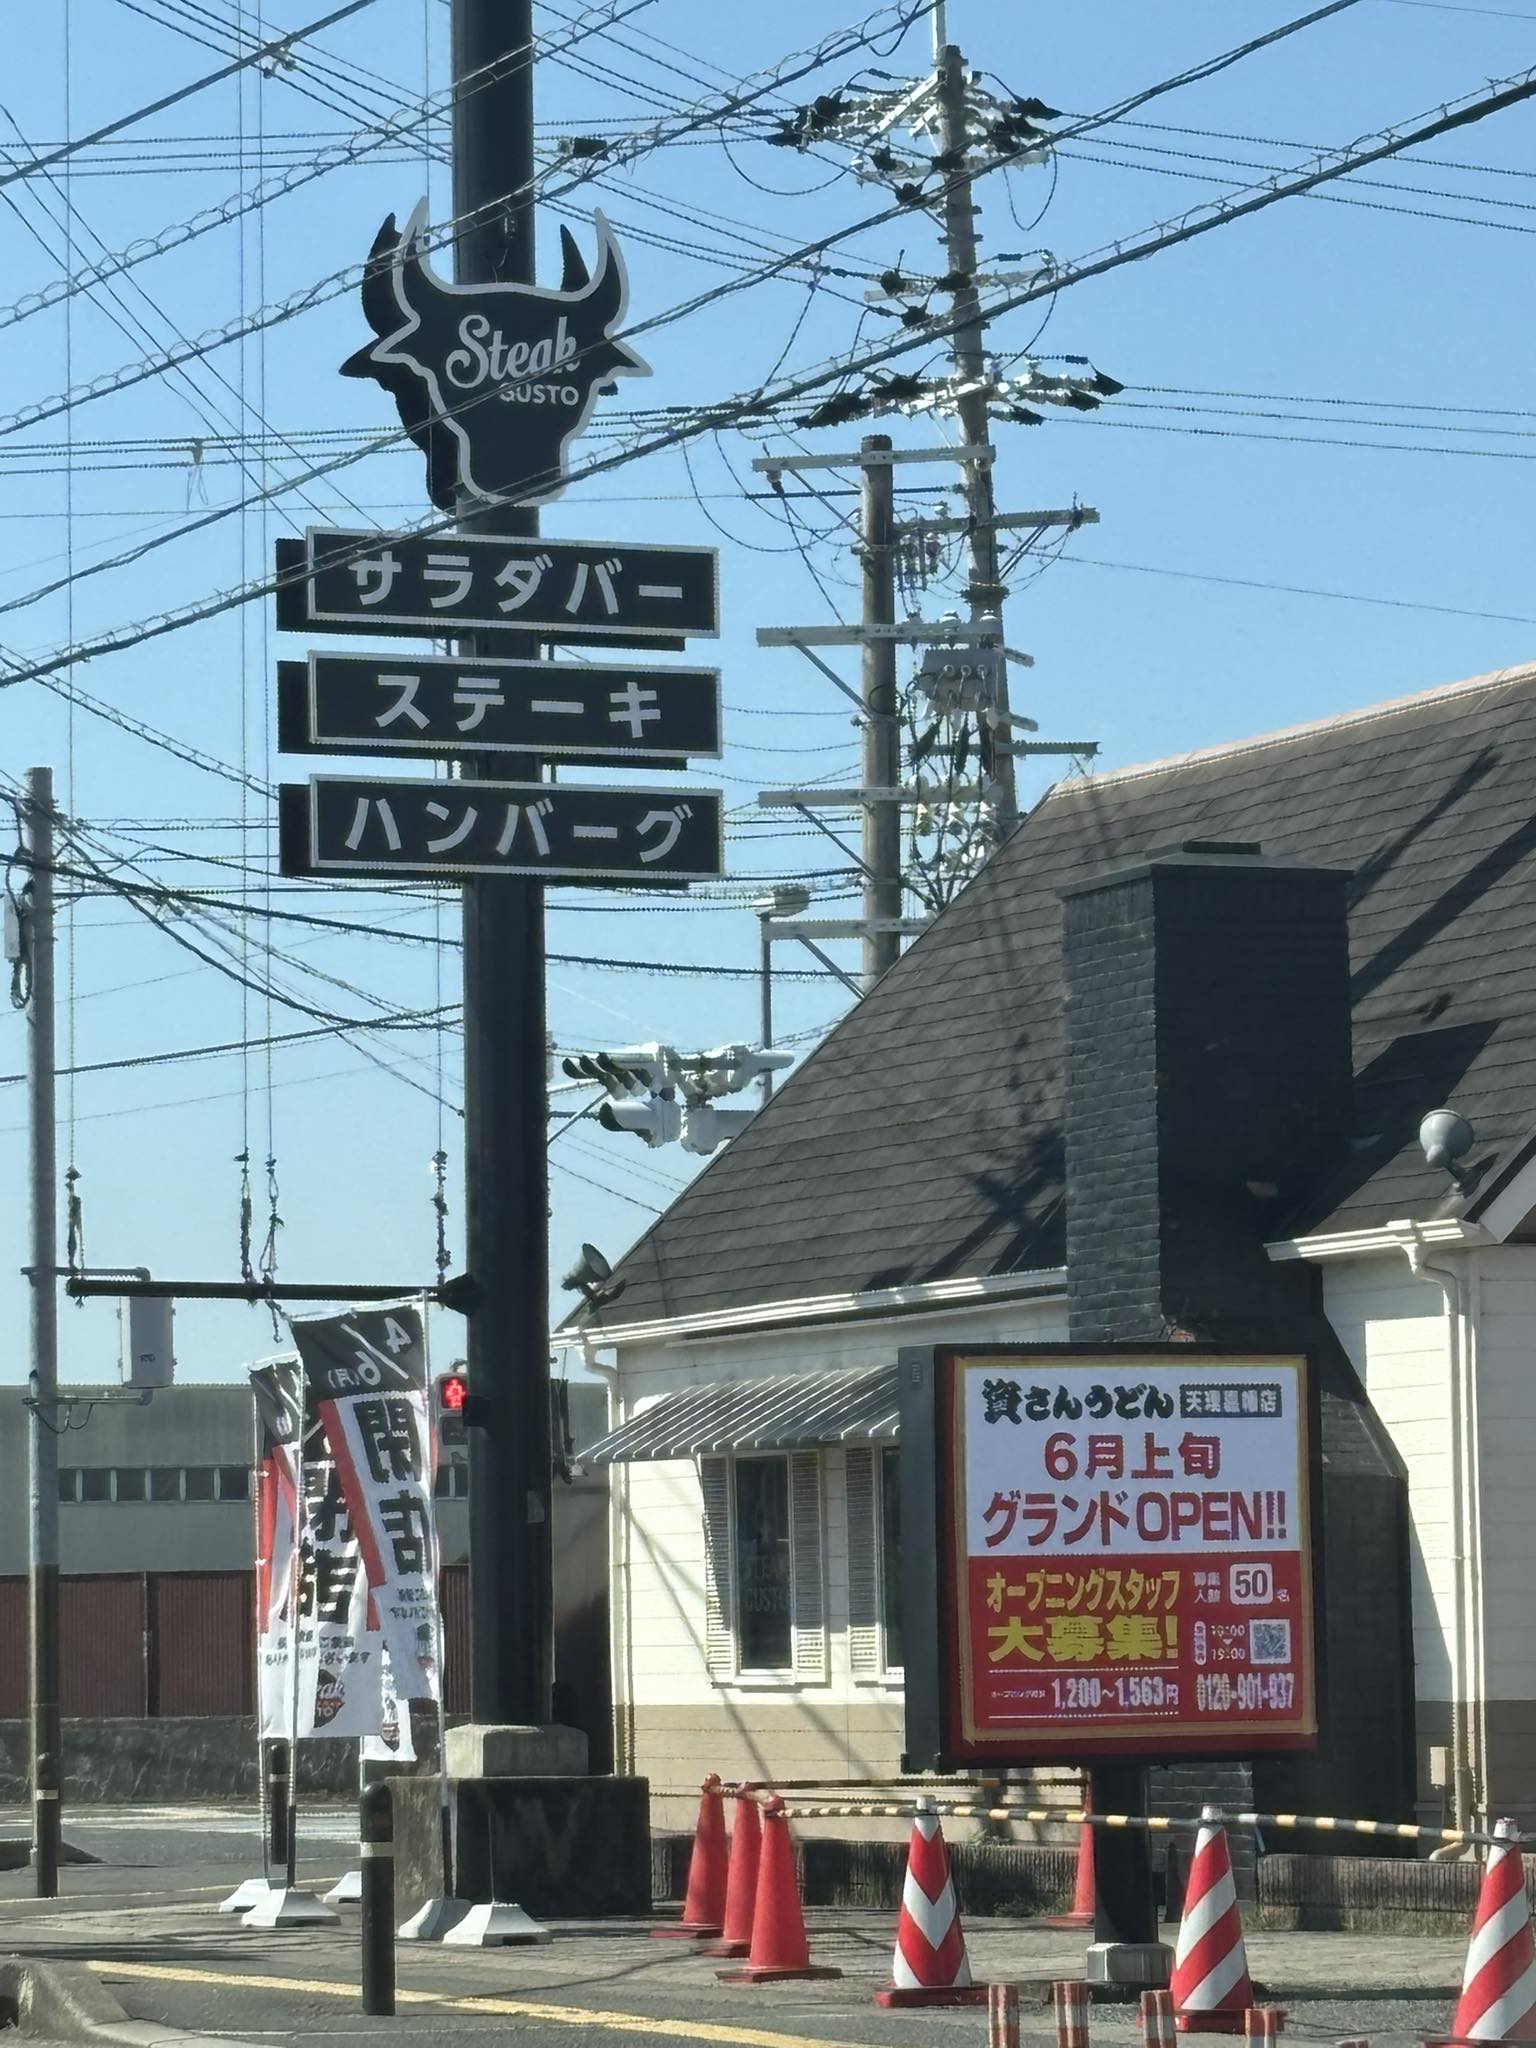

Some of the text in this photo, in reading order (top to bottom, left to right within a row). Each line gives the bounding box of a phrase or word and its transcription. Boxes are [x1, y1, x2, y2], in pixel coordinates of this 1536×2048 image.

[445, 314, 581, 388] Steak
[499, 382, 580, 407] GUSTO
[347, 550, 683, 615] サラダバー
[375, 674, 661, 739] ステーキ
[344, 797, 694, 863] ハンバーグ
[981, 1377, 1175, 1425] 資さんうどん
[1044, 1432, 1222, 1481] 6月上旬
[981, 1490, 1288, 1548] グランドOPEN!!
[986, 1568, 1181, 1612] オープニングスタッフ
[1235, 1569, 1269, 1599] 50
[987, 1615, 1179, 1663] 大募集!
